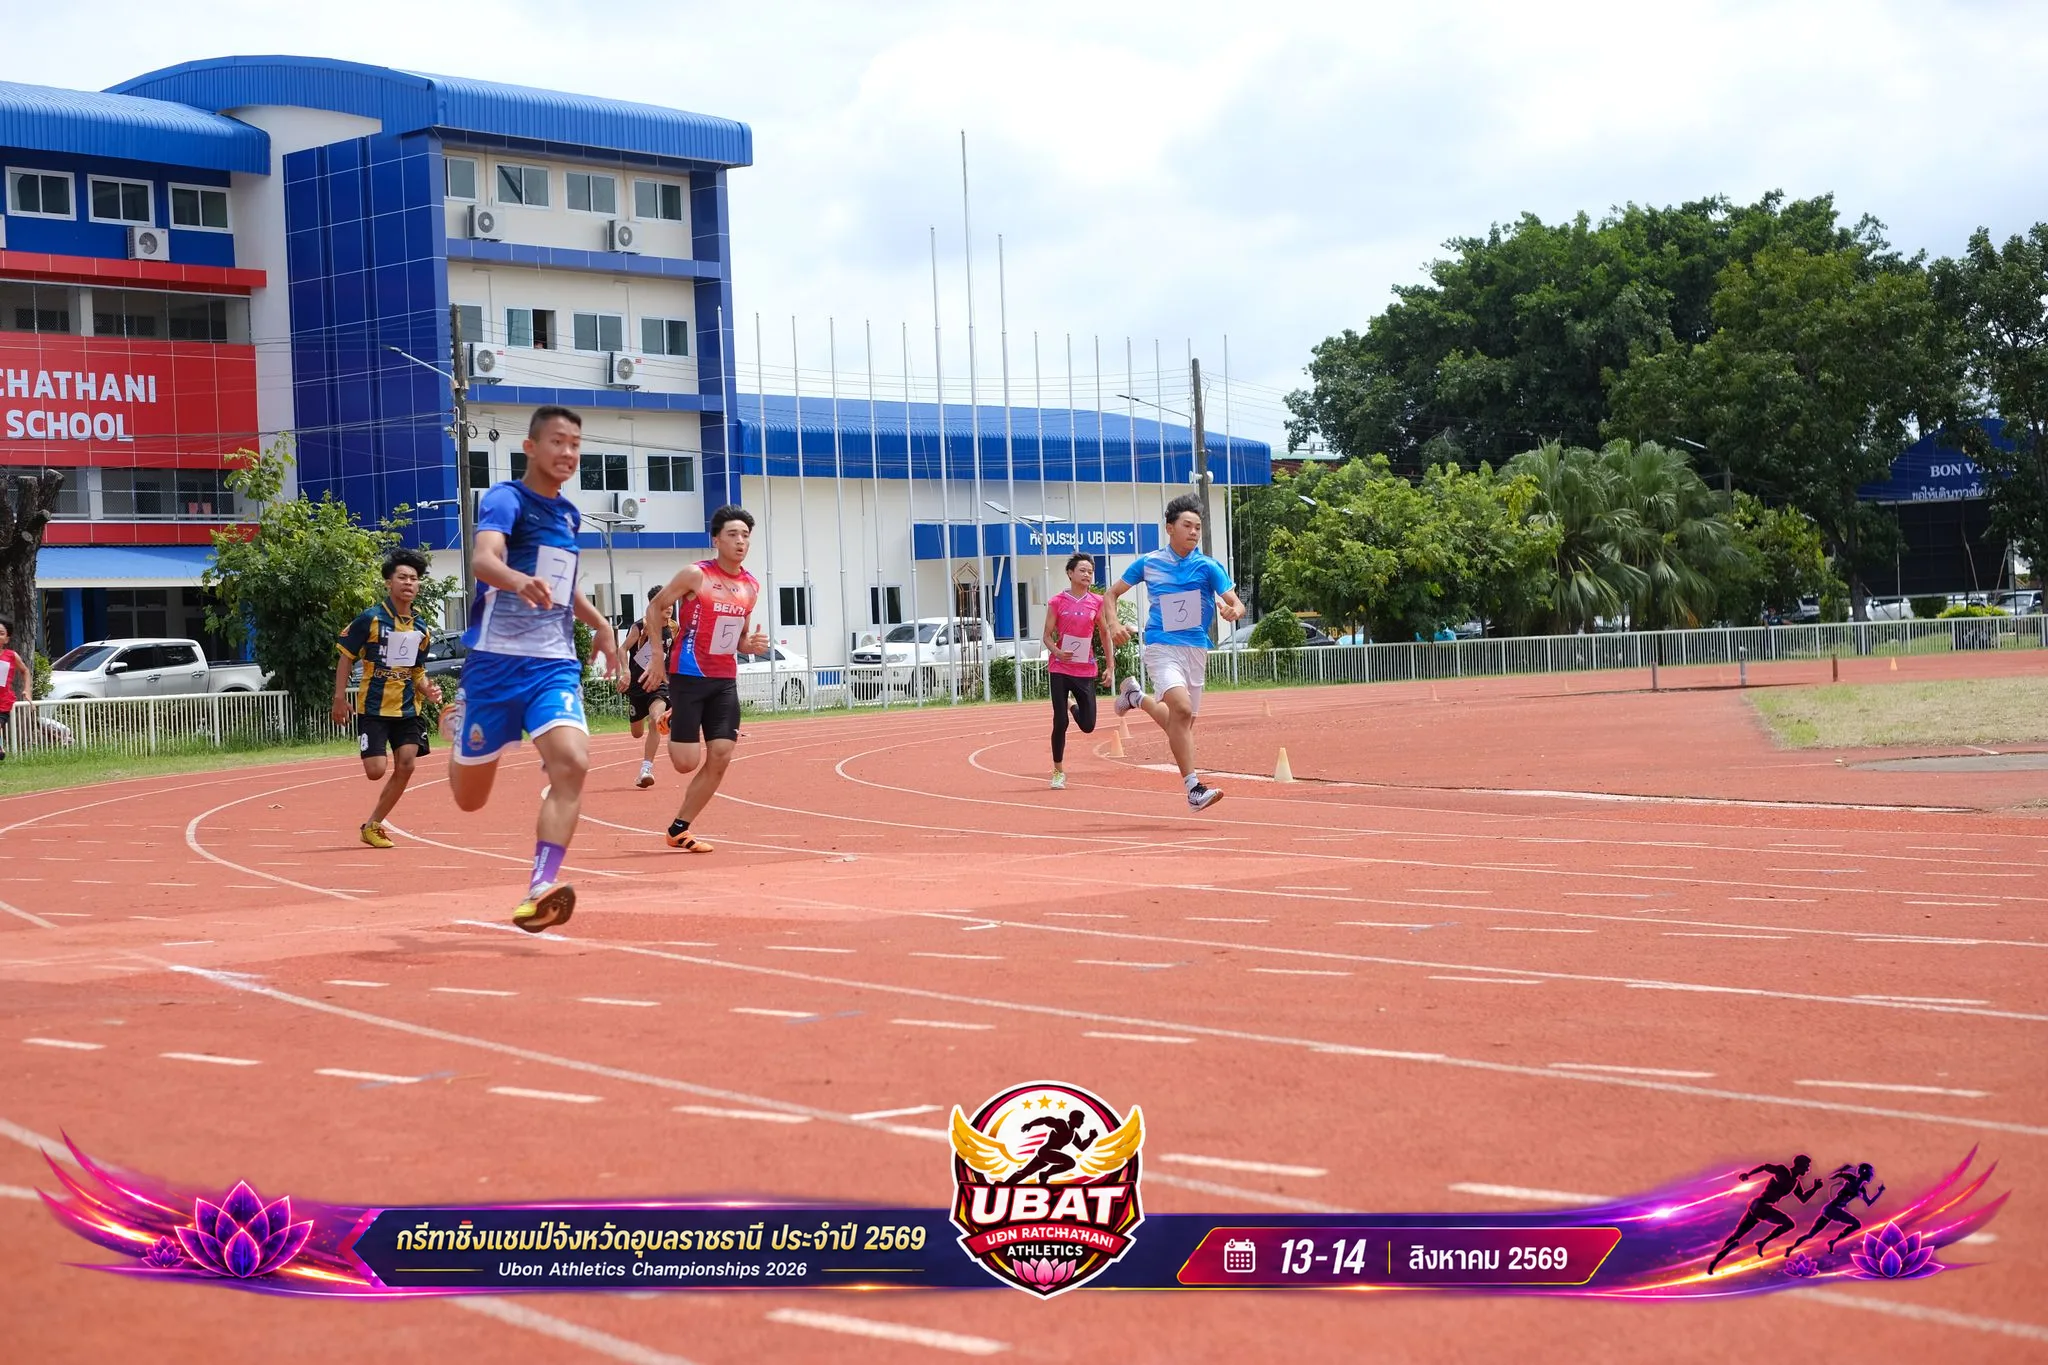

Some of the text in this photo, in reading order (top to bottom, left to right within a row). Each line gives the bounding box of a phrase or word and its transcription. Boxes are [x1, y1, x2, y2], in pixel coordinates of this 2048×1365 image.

[0, 369, 157, 403] HATHANI
[6, 409, 134, 442] SCHOOL
[1930, 463, 1961, 478] BON
[1128, 530, 1134, 545] 1
[552, 557, 568, 591] 7
[1172, 599, 1189, 623] 3
[399, 636, 409, 657] 6
[719, 624, 737, 649] 5
[1070, 640, 1082, 658] 2
